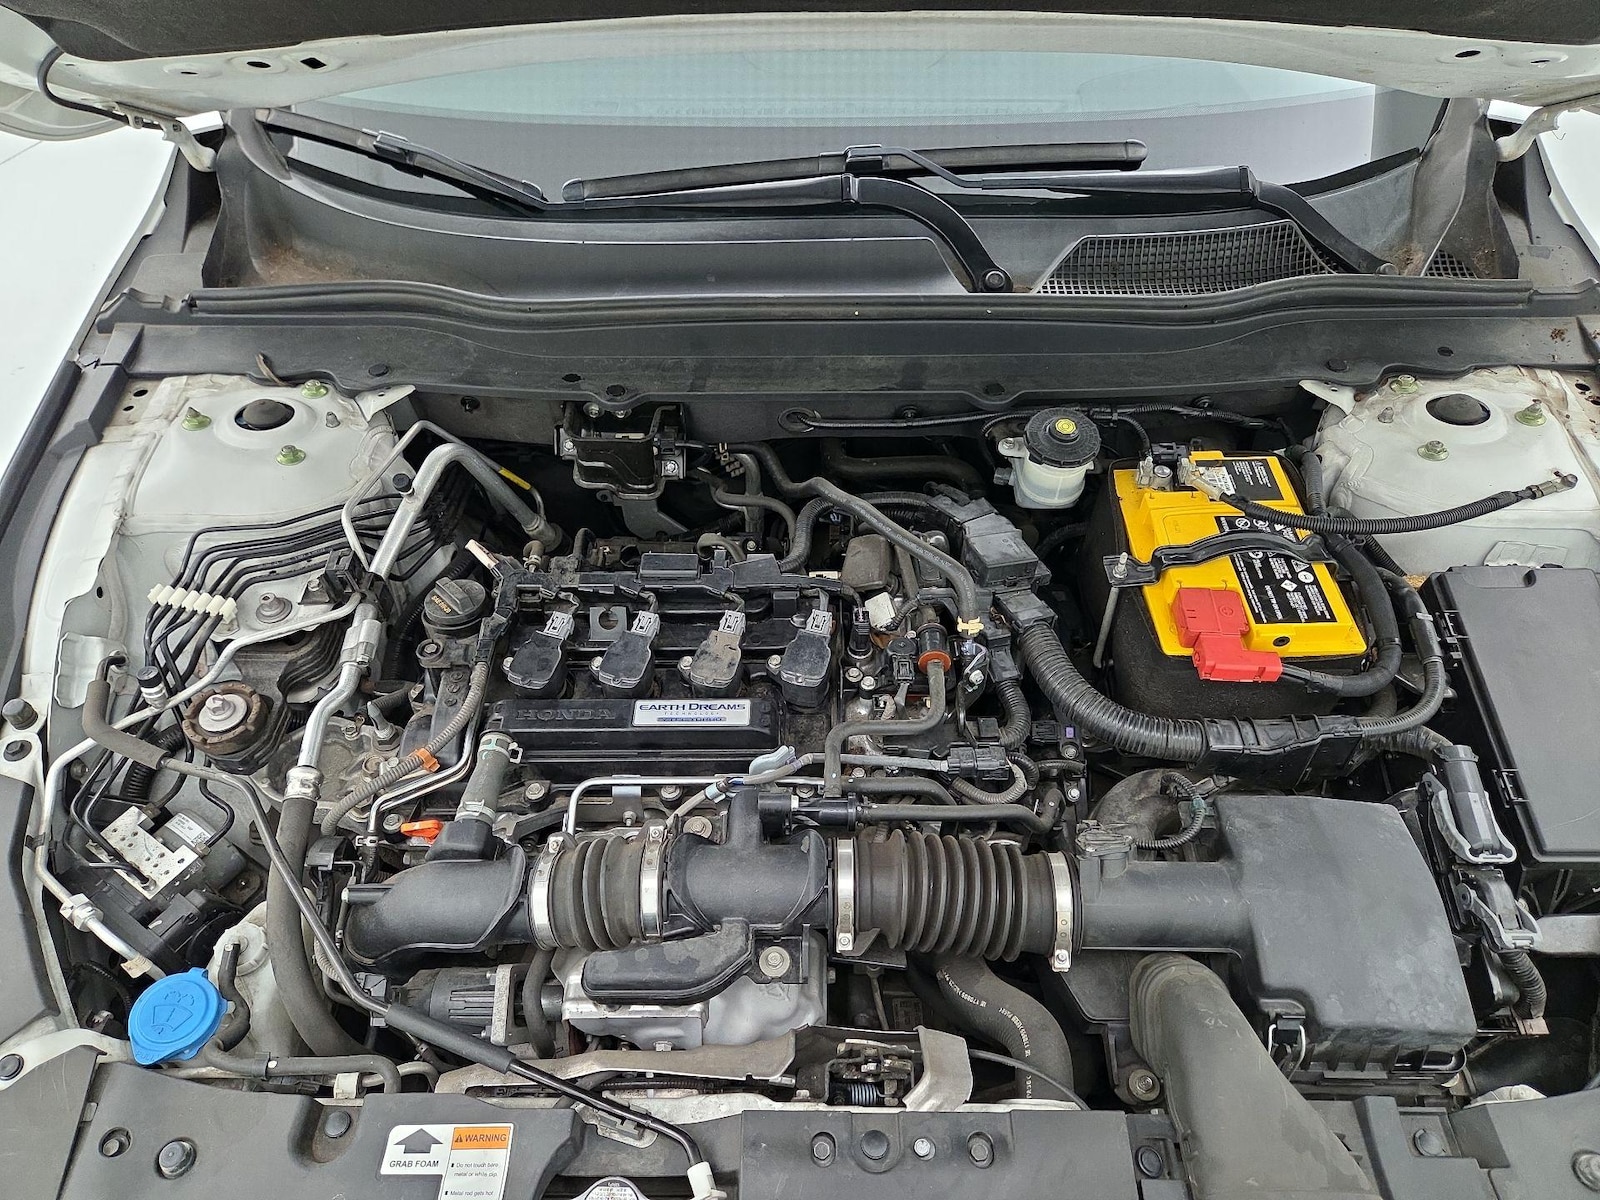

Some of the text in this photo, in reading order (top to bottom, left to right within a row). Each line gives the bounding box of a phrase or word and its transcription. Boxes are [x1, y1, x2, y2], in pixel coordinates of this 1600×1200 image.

[688, 703, 746, 711] DREAMS
[516, 709, 615, 720] HONDA
[465, 1133, 507, 1142] WARNING
[389, 1160, 439, 1168] GRAB FOAM
